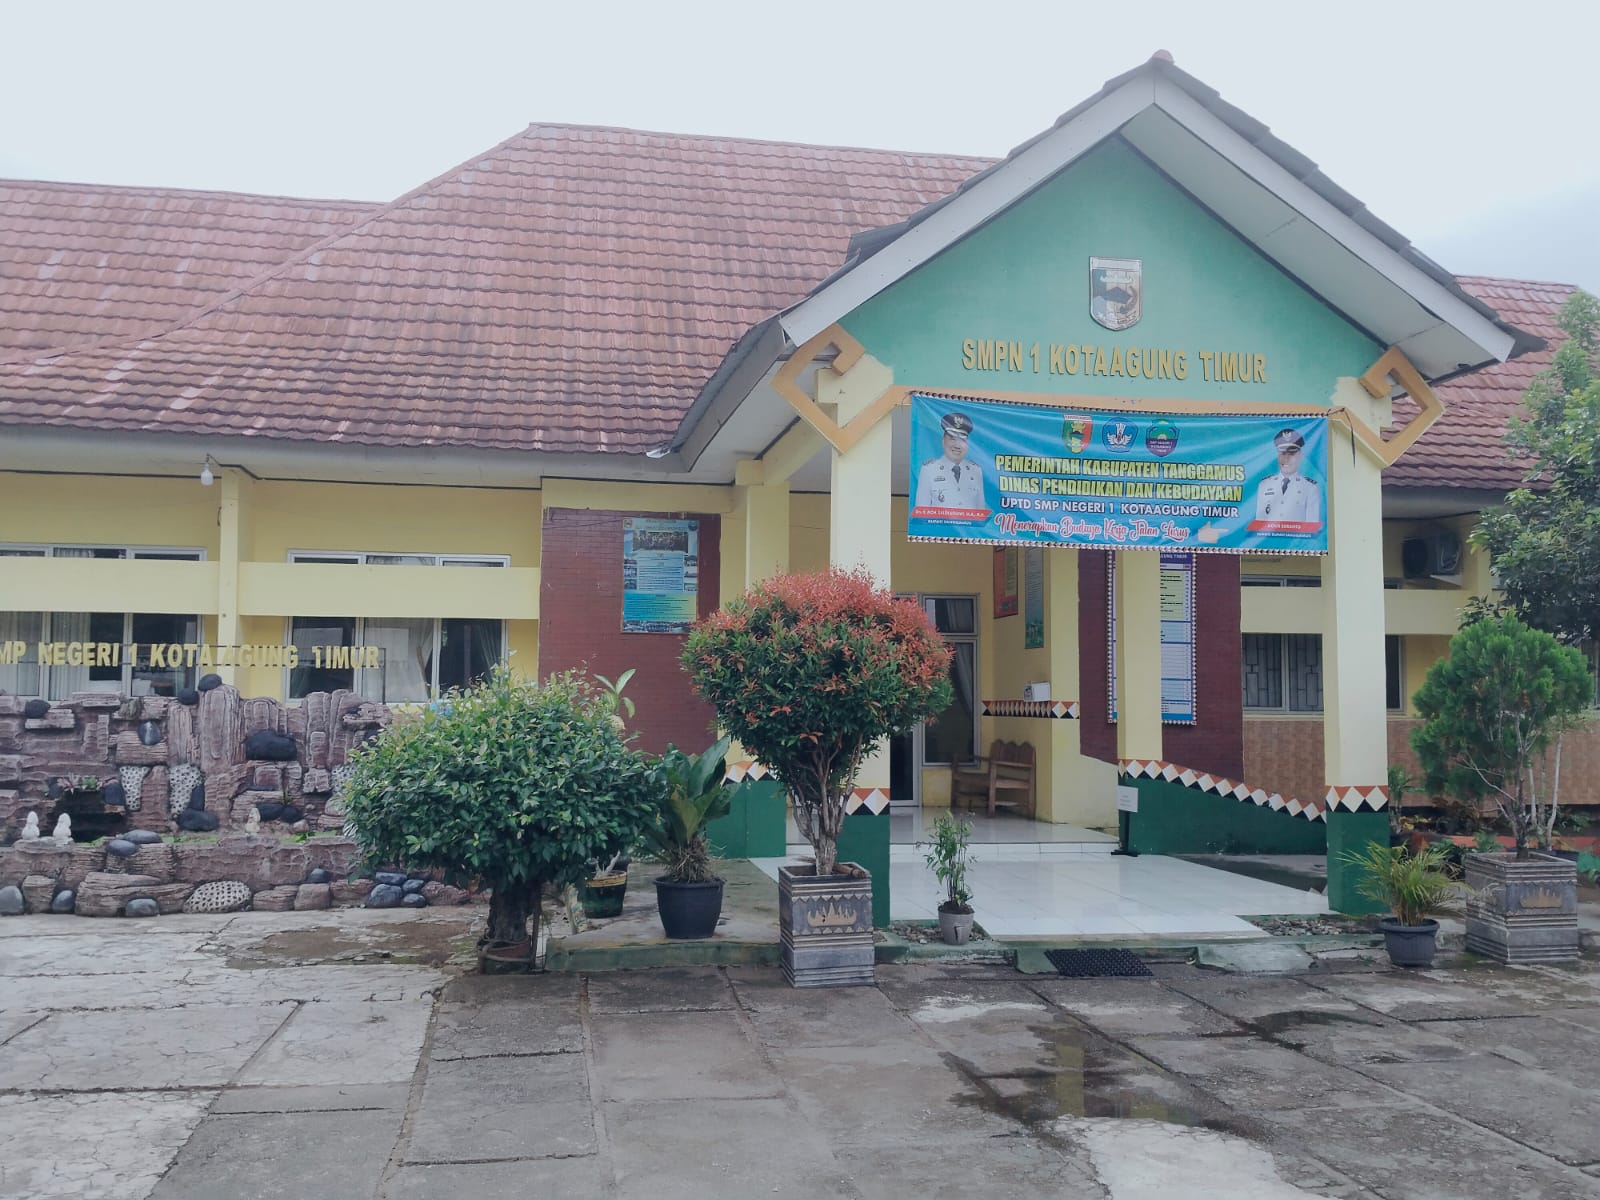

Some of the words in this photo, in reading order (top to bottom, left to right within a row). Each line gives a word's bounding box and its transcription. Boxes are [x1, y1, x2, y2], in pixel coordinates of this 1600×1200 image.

[962, 338, 1022, 373] SMPN
[1030, 341, 1040, 374] 1
[1050, 343, 1187, 380] KOTAAGUNG
[1199, 351, 1267, 383] TIMUR
[995, 454, 1080, 474] PEMERINTAH
[1083, 458, 1159, 478] KABUPATEN
[1162, 463, 1245, 481] TANGGAMUS
[999, 475, 1040, 494] DINAS
[1042, 478, 1123, 497] PENDIDIKAN
[1125, 482, 1153, 498] DAN
[1156, 483, 1242, 502] KEBUDAYAAN
[1001, 497, 1031, 509] UPTD
[1034, 499, 1059, 511] SMP
[1062, 501, 1105, 513] NEGERI
[1109, 502, 1115, 514] 1
[1121, 503, 1199, 516] KOTAAGUNG
[1202, 506, 1239, 518] TIMUR
[994, 513, 1059, 537] Menerapkan
[1060, 516, 1101, 539] Budaya
[1129, 519, 1159, 541] Jalan
[38, 641, 119, 667] NEGERI
[129, 643, 138, 667] 1
[149, 643, 214, 668] KOTA
[221, 644, 298, 669] AGUNG
[311, 645, 380, 669] TIMUR
